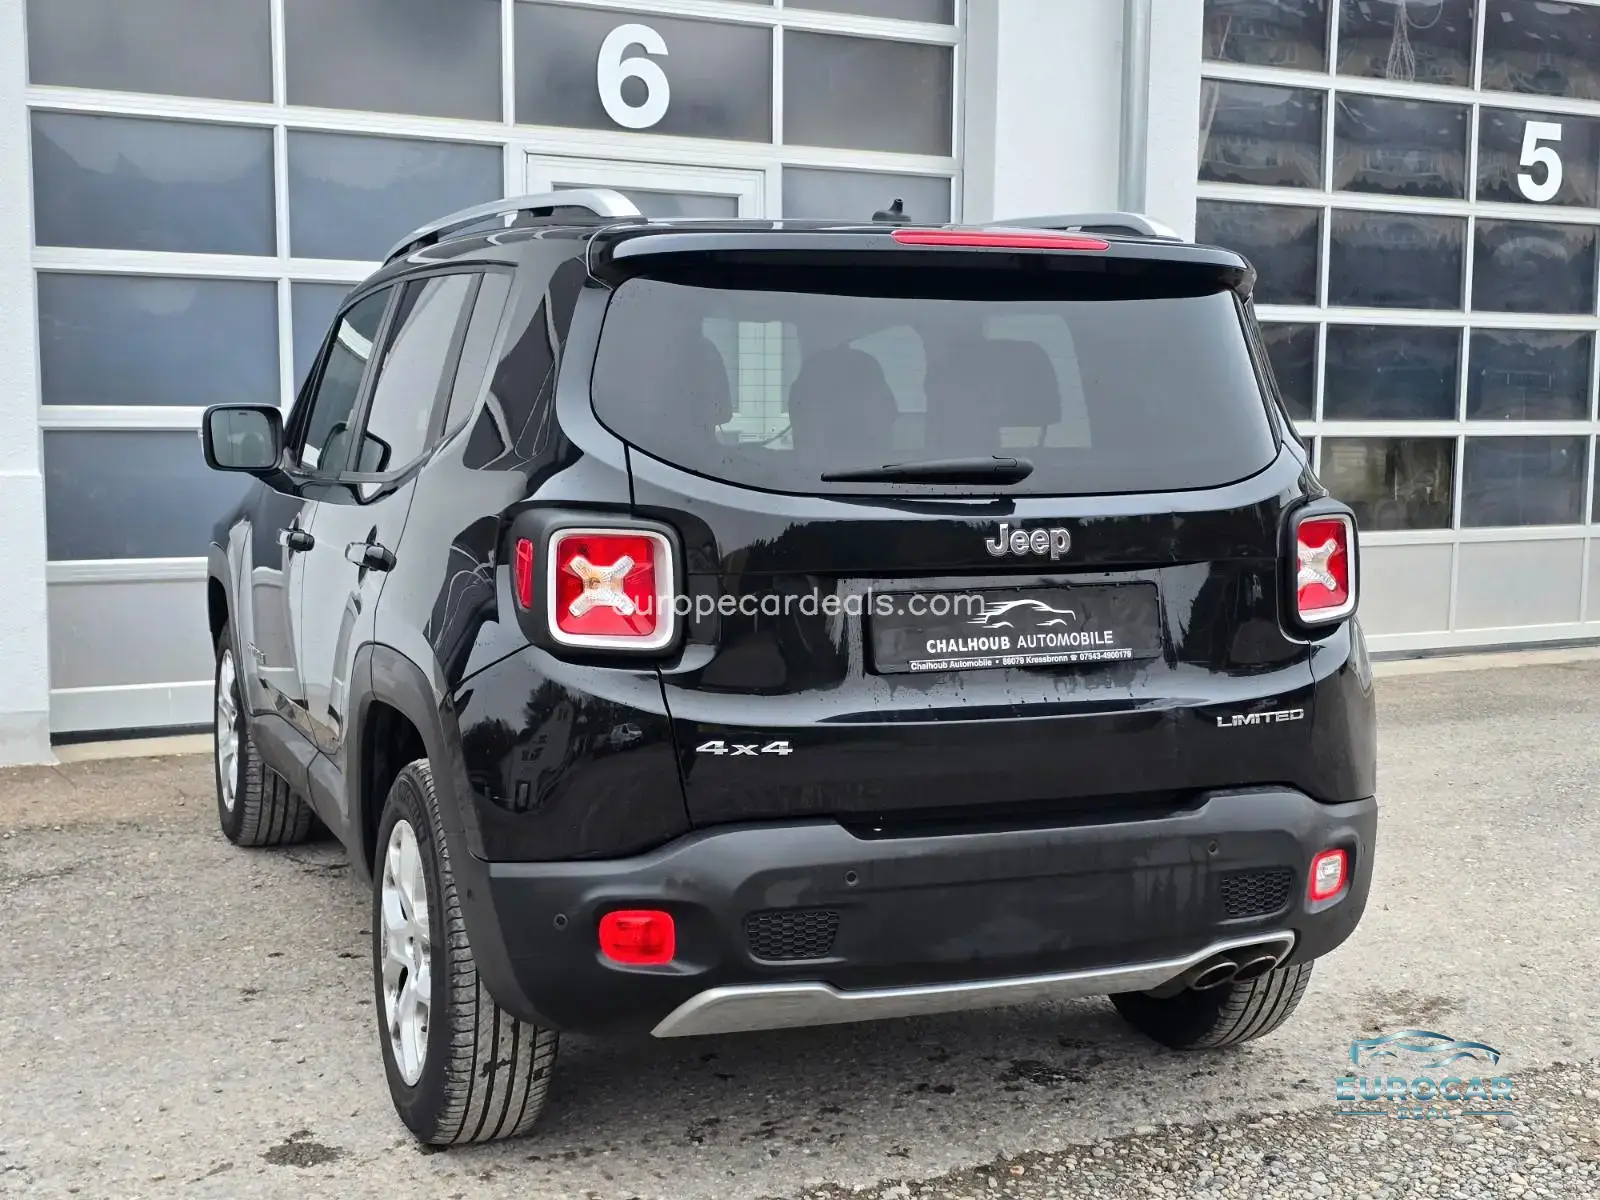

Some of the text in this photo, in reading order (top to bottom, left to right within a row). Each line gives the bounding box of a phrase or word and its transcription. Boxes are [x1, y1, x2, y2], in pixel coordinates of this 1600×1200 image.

[597, 23, 670, 129] 6
[1517, 120, 1563, 202] 5
[985, 523, 1071, 560] Jeep
[926, 630, 1114, 654] CHALHOUB AUTOMOBILE
[910, 661, 948, 671] Chalhoub
[949, 658, 992, 669] Automobile
[1216, 708, 1305, 728] LIMITED
[695, 740, 793, 756] 4x4
